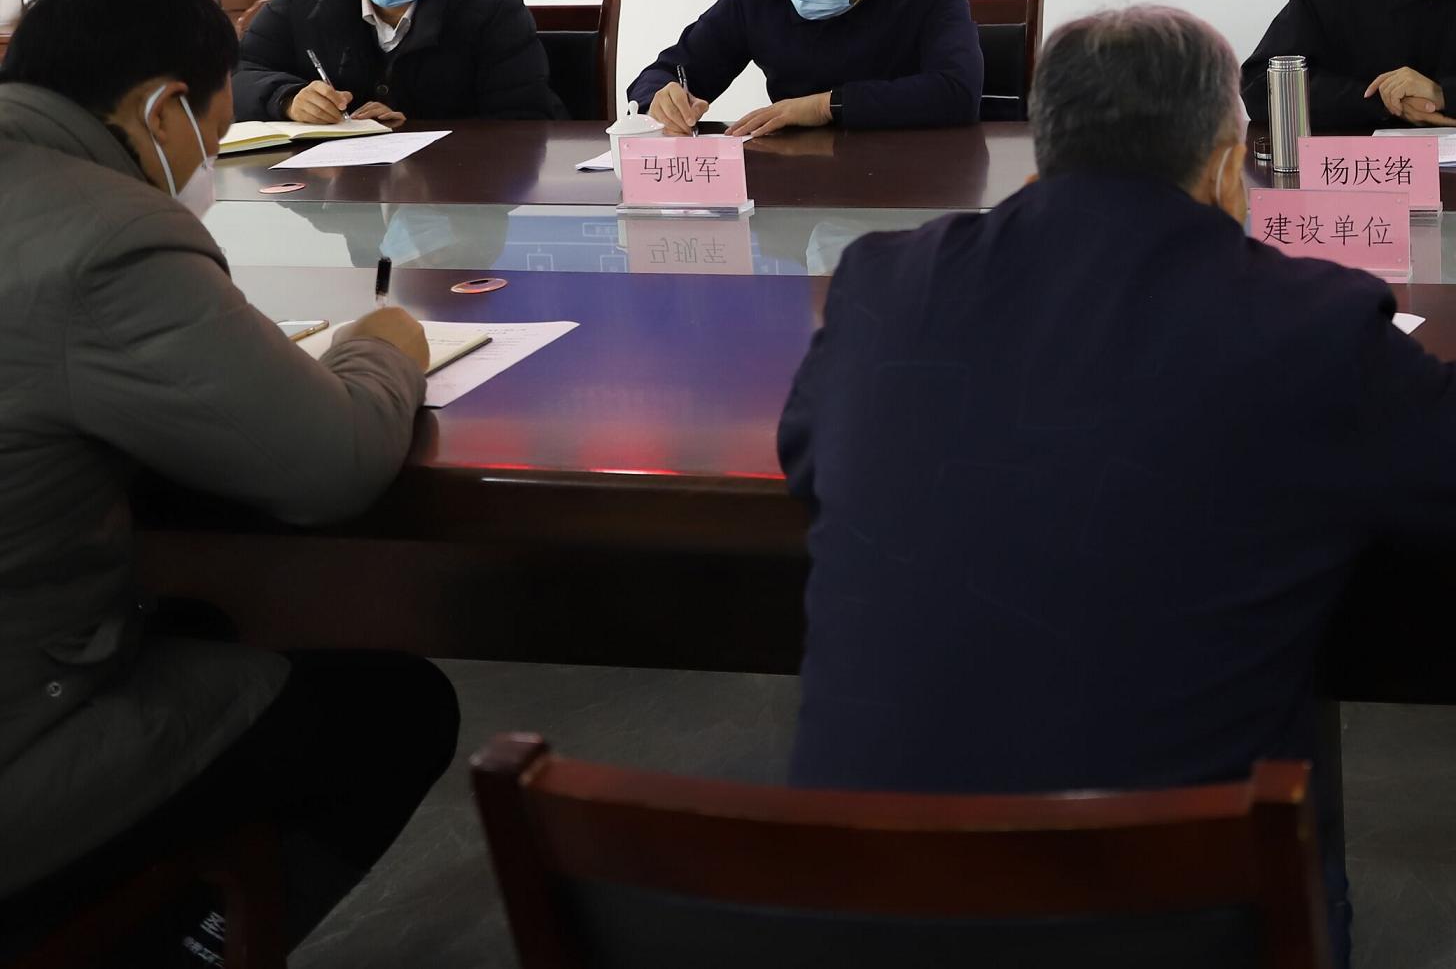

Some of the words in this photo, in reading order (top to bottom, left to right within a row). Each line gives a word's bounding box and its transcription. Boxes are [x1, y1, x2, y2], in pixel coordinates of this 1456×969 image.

[640, 154, 721, 183] 马现军
[1321, 156, 1414, 186] 杨庆绪
[1263, 212, 1394, 248] 建设单位
